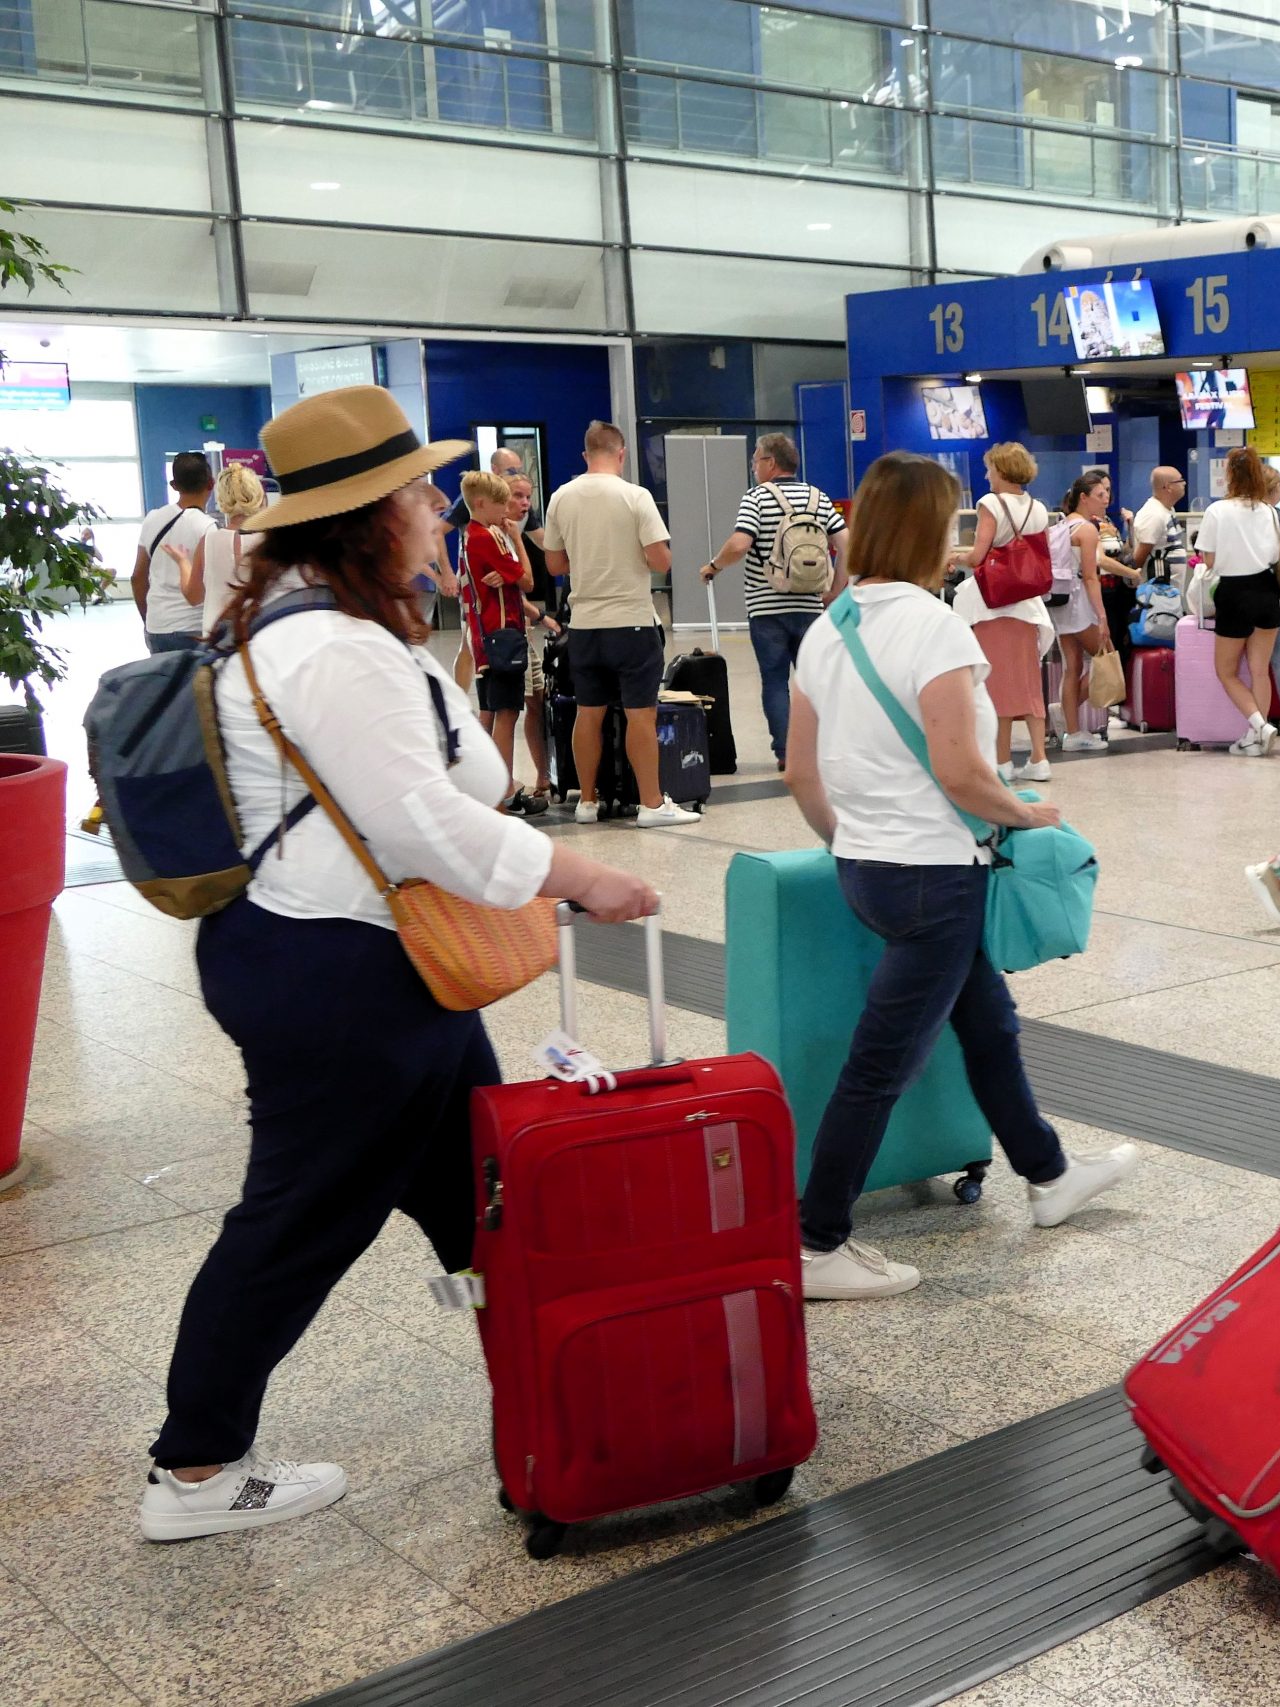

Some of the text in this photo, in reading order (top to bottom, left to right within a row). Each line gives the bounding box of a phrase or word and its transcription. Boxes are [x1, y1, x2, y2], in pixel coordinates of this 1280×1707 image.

[929, 302, 964, 355] 13
[1030, 291, 1071, 347] 14
[1185, 274, 1230, 335] 15
